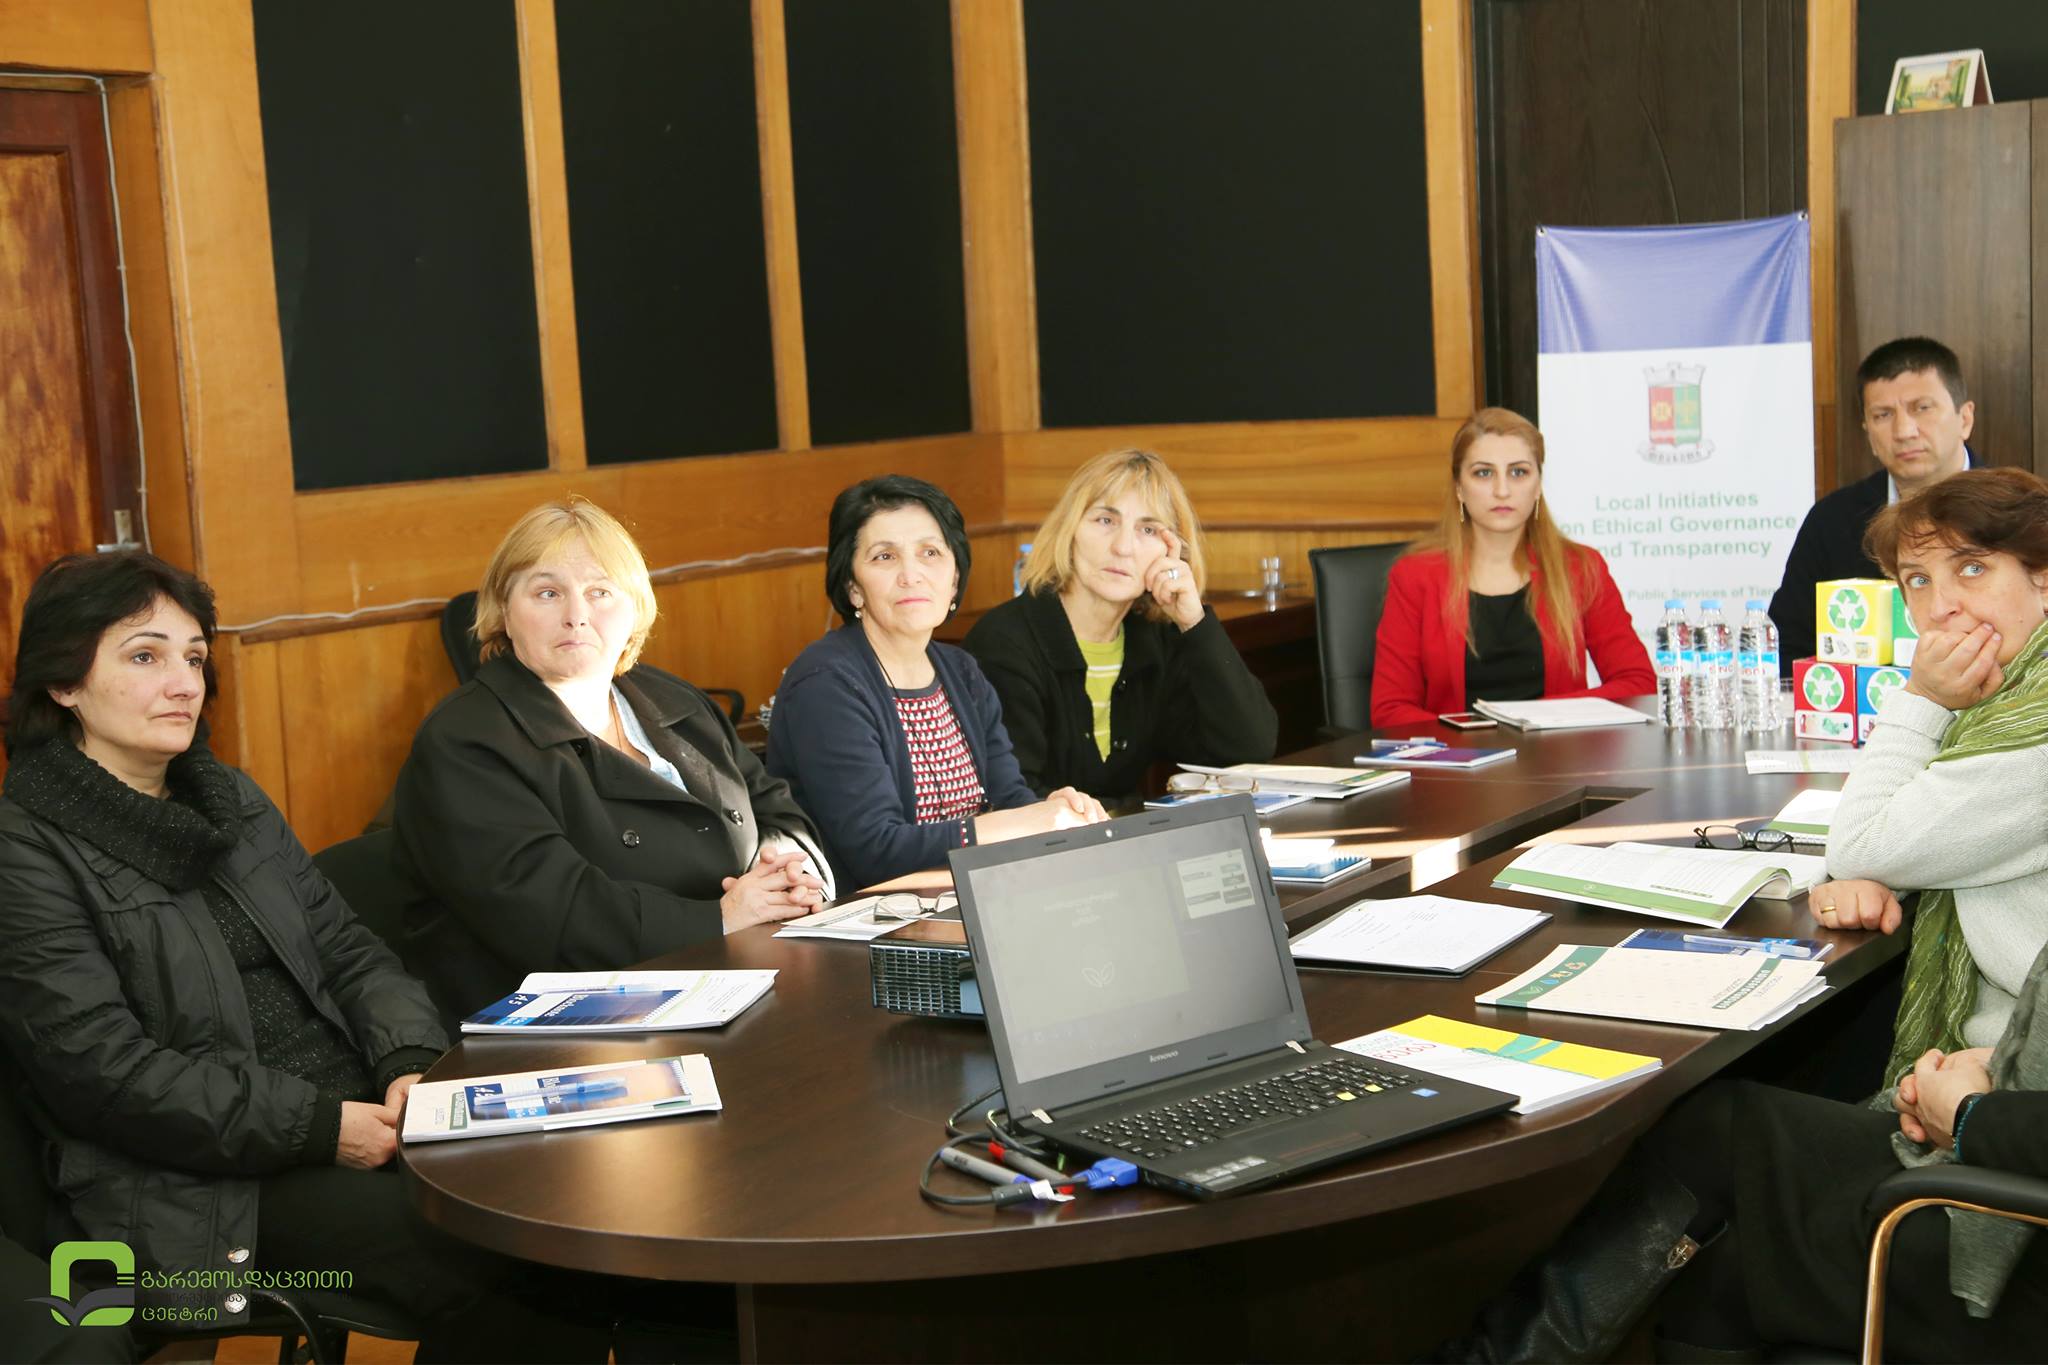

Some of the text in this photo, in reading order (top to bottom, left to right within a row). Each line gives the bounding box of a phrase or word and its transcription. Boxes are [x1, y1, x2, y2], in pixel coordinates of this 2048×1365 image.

[1595, 491, 1759, 511] Local Initiatives
[1560, 515, 1797, 535] on Ethical Governance
[1601, 540, 1772, 560] nd Transparency
[1628, 586, 1776, 600] Public Services of Tian
[1149, 1049, 1180, 1064] lenovo
